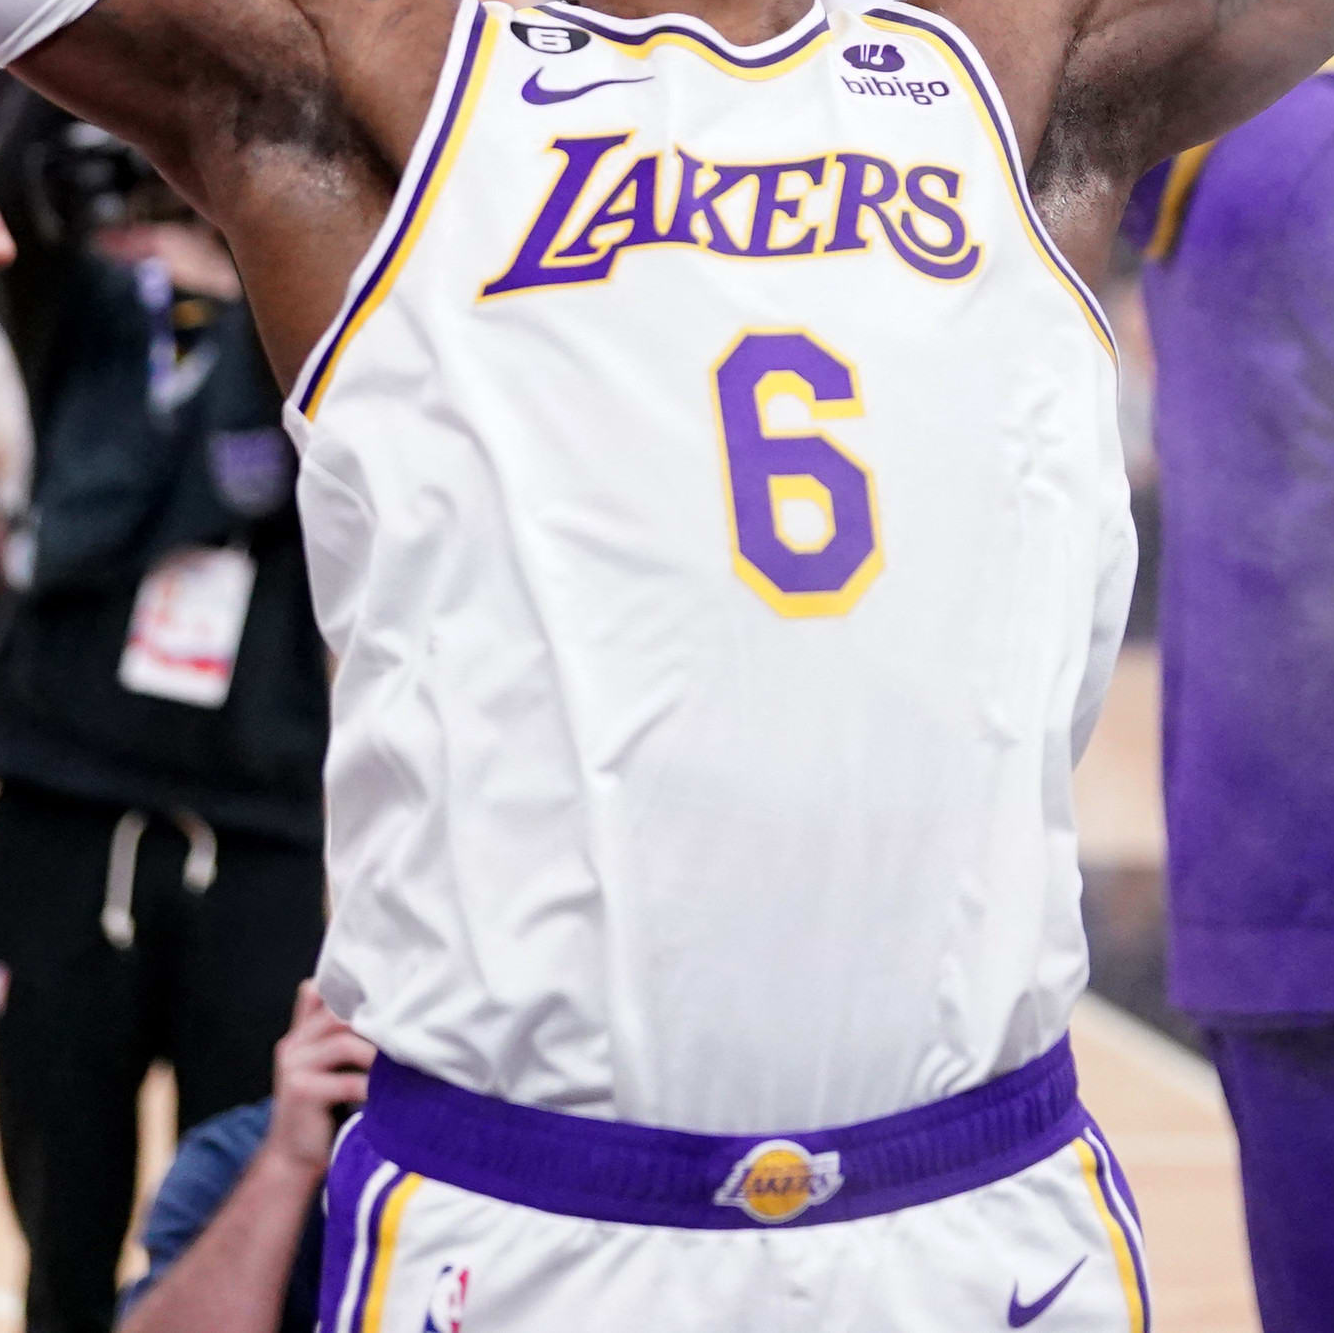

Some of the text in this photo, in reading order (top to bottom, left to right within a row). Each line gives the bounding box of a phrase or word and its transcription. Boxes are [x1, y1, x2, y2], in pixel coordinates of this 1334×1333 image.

[527, 27, 572, 53] 6
[841, 75, 950, 105] bibigo
[475, 130, 985, 303] LAKERS
[709, 327, 884, 618] 6
